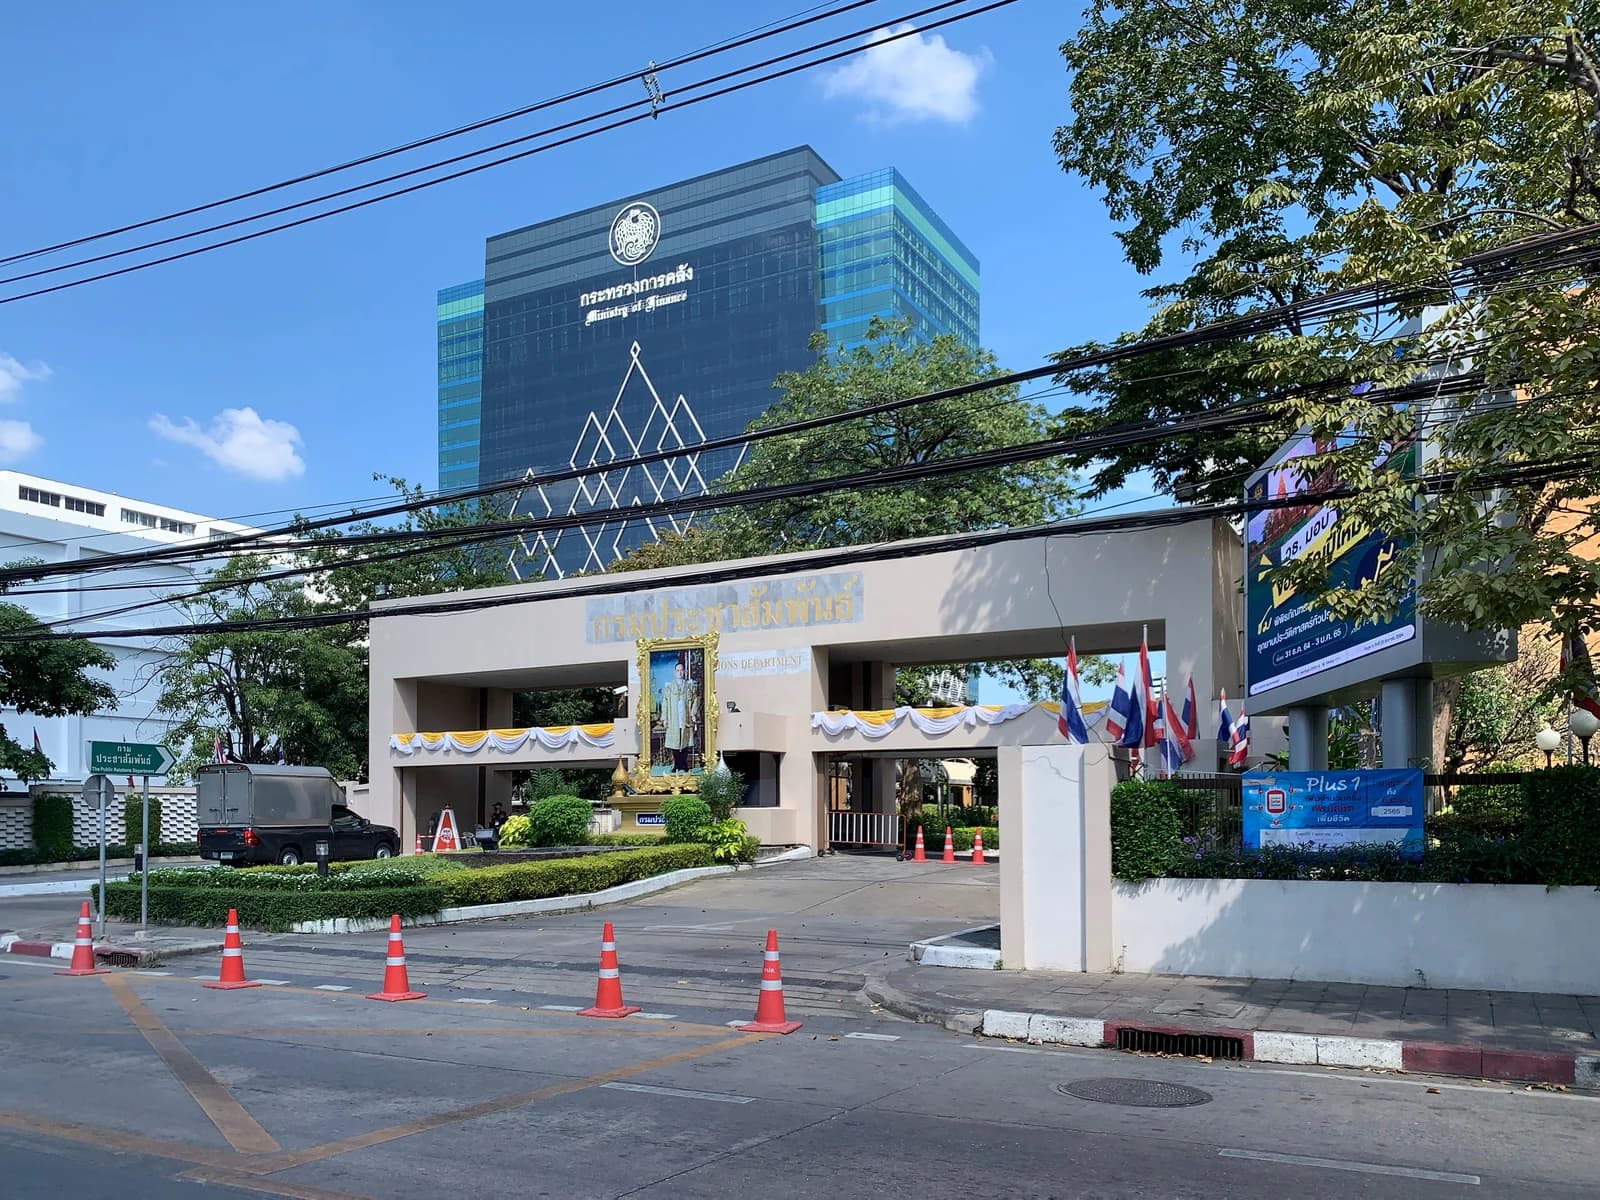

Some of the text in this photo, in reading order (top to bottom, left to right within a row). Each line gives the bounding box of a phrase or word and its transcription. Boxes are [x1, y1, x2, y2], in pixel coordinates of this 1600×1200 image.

[580, 263, 693, 307] กระทรวงการคลัง
[585, 290, 688, 326] Ministry of Finance
[592, 575, 858, 641] กรมประชาสัมพันธ์
[1333, 627, 1342, 638] 65
[741, 656, 802, 669] DEPARTMENT
[96, 753, 152, 765] ประชาสัมพันธ์
[1306, 776, 1348, 792] Plus
[1352, 776, 1360, 791] 1
